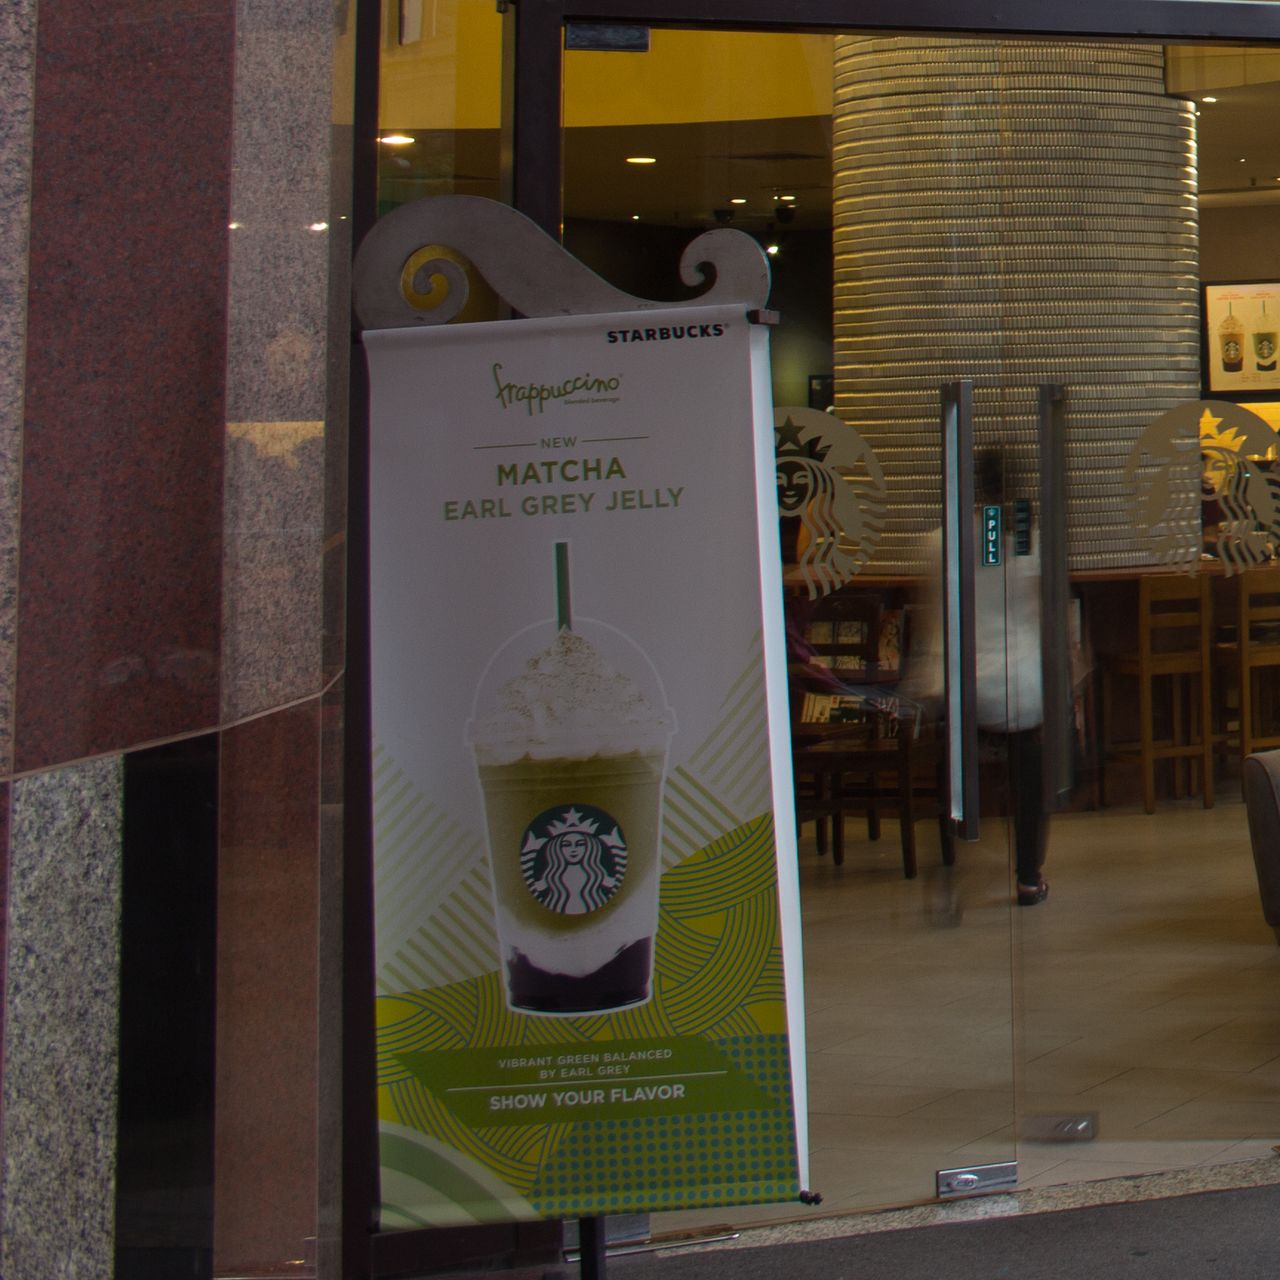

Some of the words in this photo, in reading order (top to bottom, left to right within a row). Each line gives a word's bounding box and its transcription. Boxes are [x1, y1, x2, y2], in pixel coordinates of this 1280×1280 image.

[607, 323, 724, 344] STARBUCKS
[540, 435, 578, 449] NEW
[497, 457, 627, 487] MATCHA
[443, 500, 512, 521] EARL
[521, 493, 596, 517] GREY
[604, 487, 685, 512] JELLY
[987, 520, 997, 563] PULL
[498, 1056, 554, 1070] VIBRANT
[557, 1053, 599, 1066] GREEN
[604, 1049, 673, 1063] BALANCED
[539, 1068, 556, 1080] BY
[560, 1066, 593, 1078] EARL
[597, 1063, 631, 1076] GREY
[489, 1094, 547, 1111] SHOW
[553, 1090, 605, 1108] YOUR
[610, 1084, 685, 1104] FLAVOR
